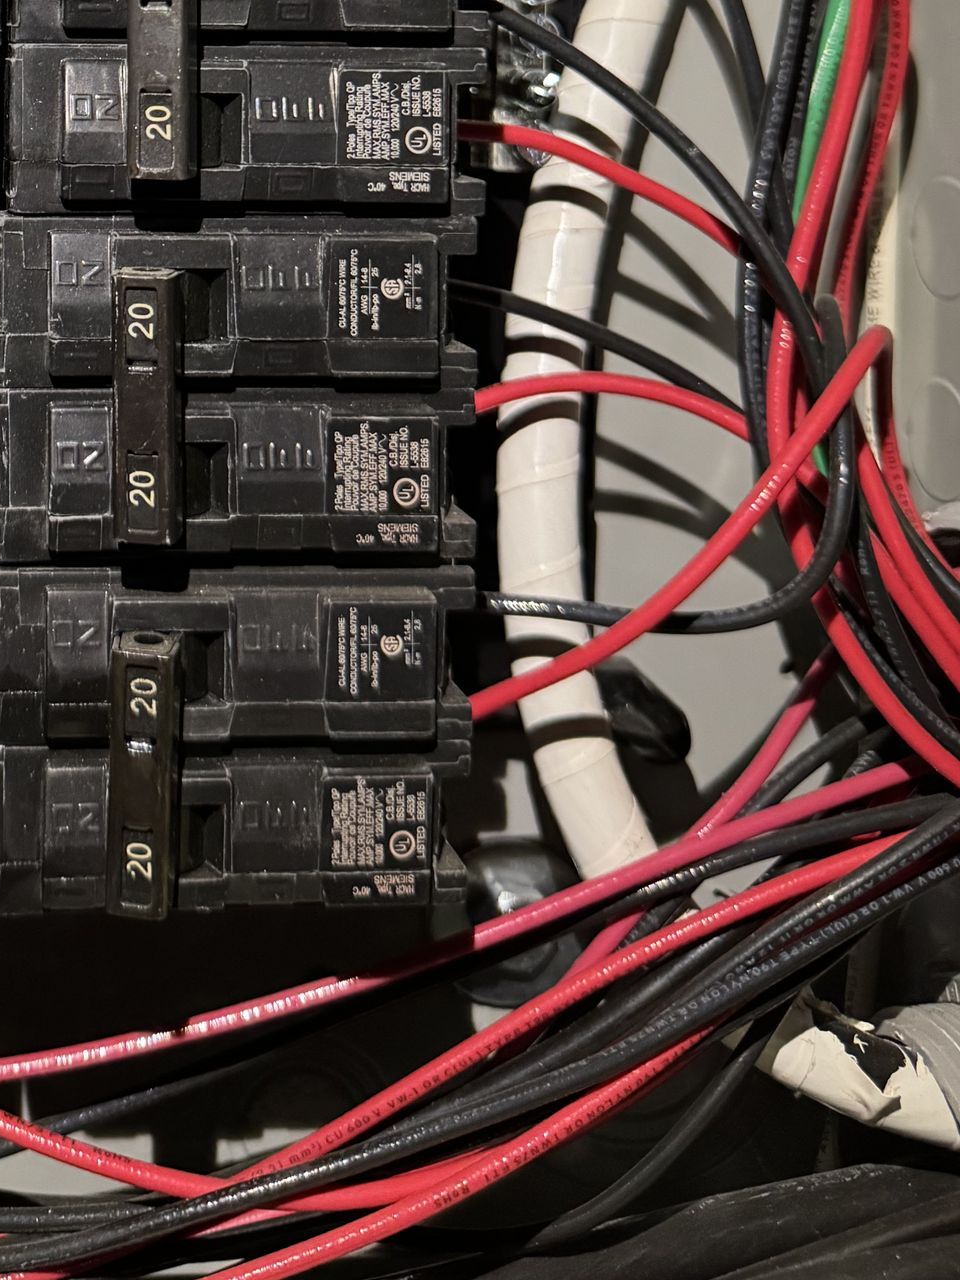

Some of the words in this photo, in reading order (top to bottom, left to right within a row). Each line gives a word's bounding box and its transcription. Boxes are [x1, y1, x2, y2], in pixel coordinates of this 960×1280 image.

[412, 74, 421, 91] NO.
[412, 91, 421, 117] ISSUE
[144, 104, 172, 140] 20
[432, 122, 442, 156] LISTED
[388, 171, 431, 182] SIEMENS
[410, 182, 431, 193] HACR
[127, 300, 155, 341] 20
[127, 469, 156, 508] 20
[421, 474, 430, 508] LISTED
[129, 676, 158, 717] 20
[125, 841, 154, 882] 20
